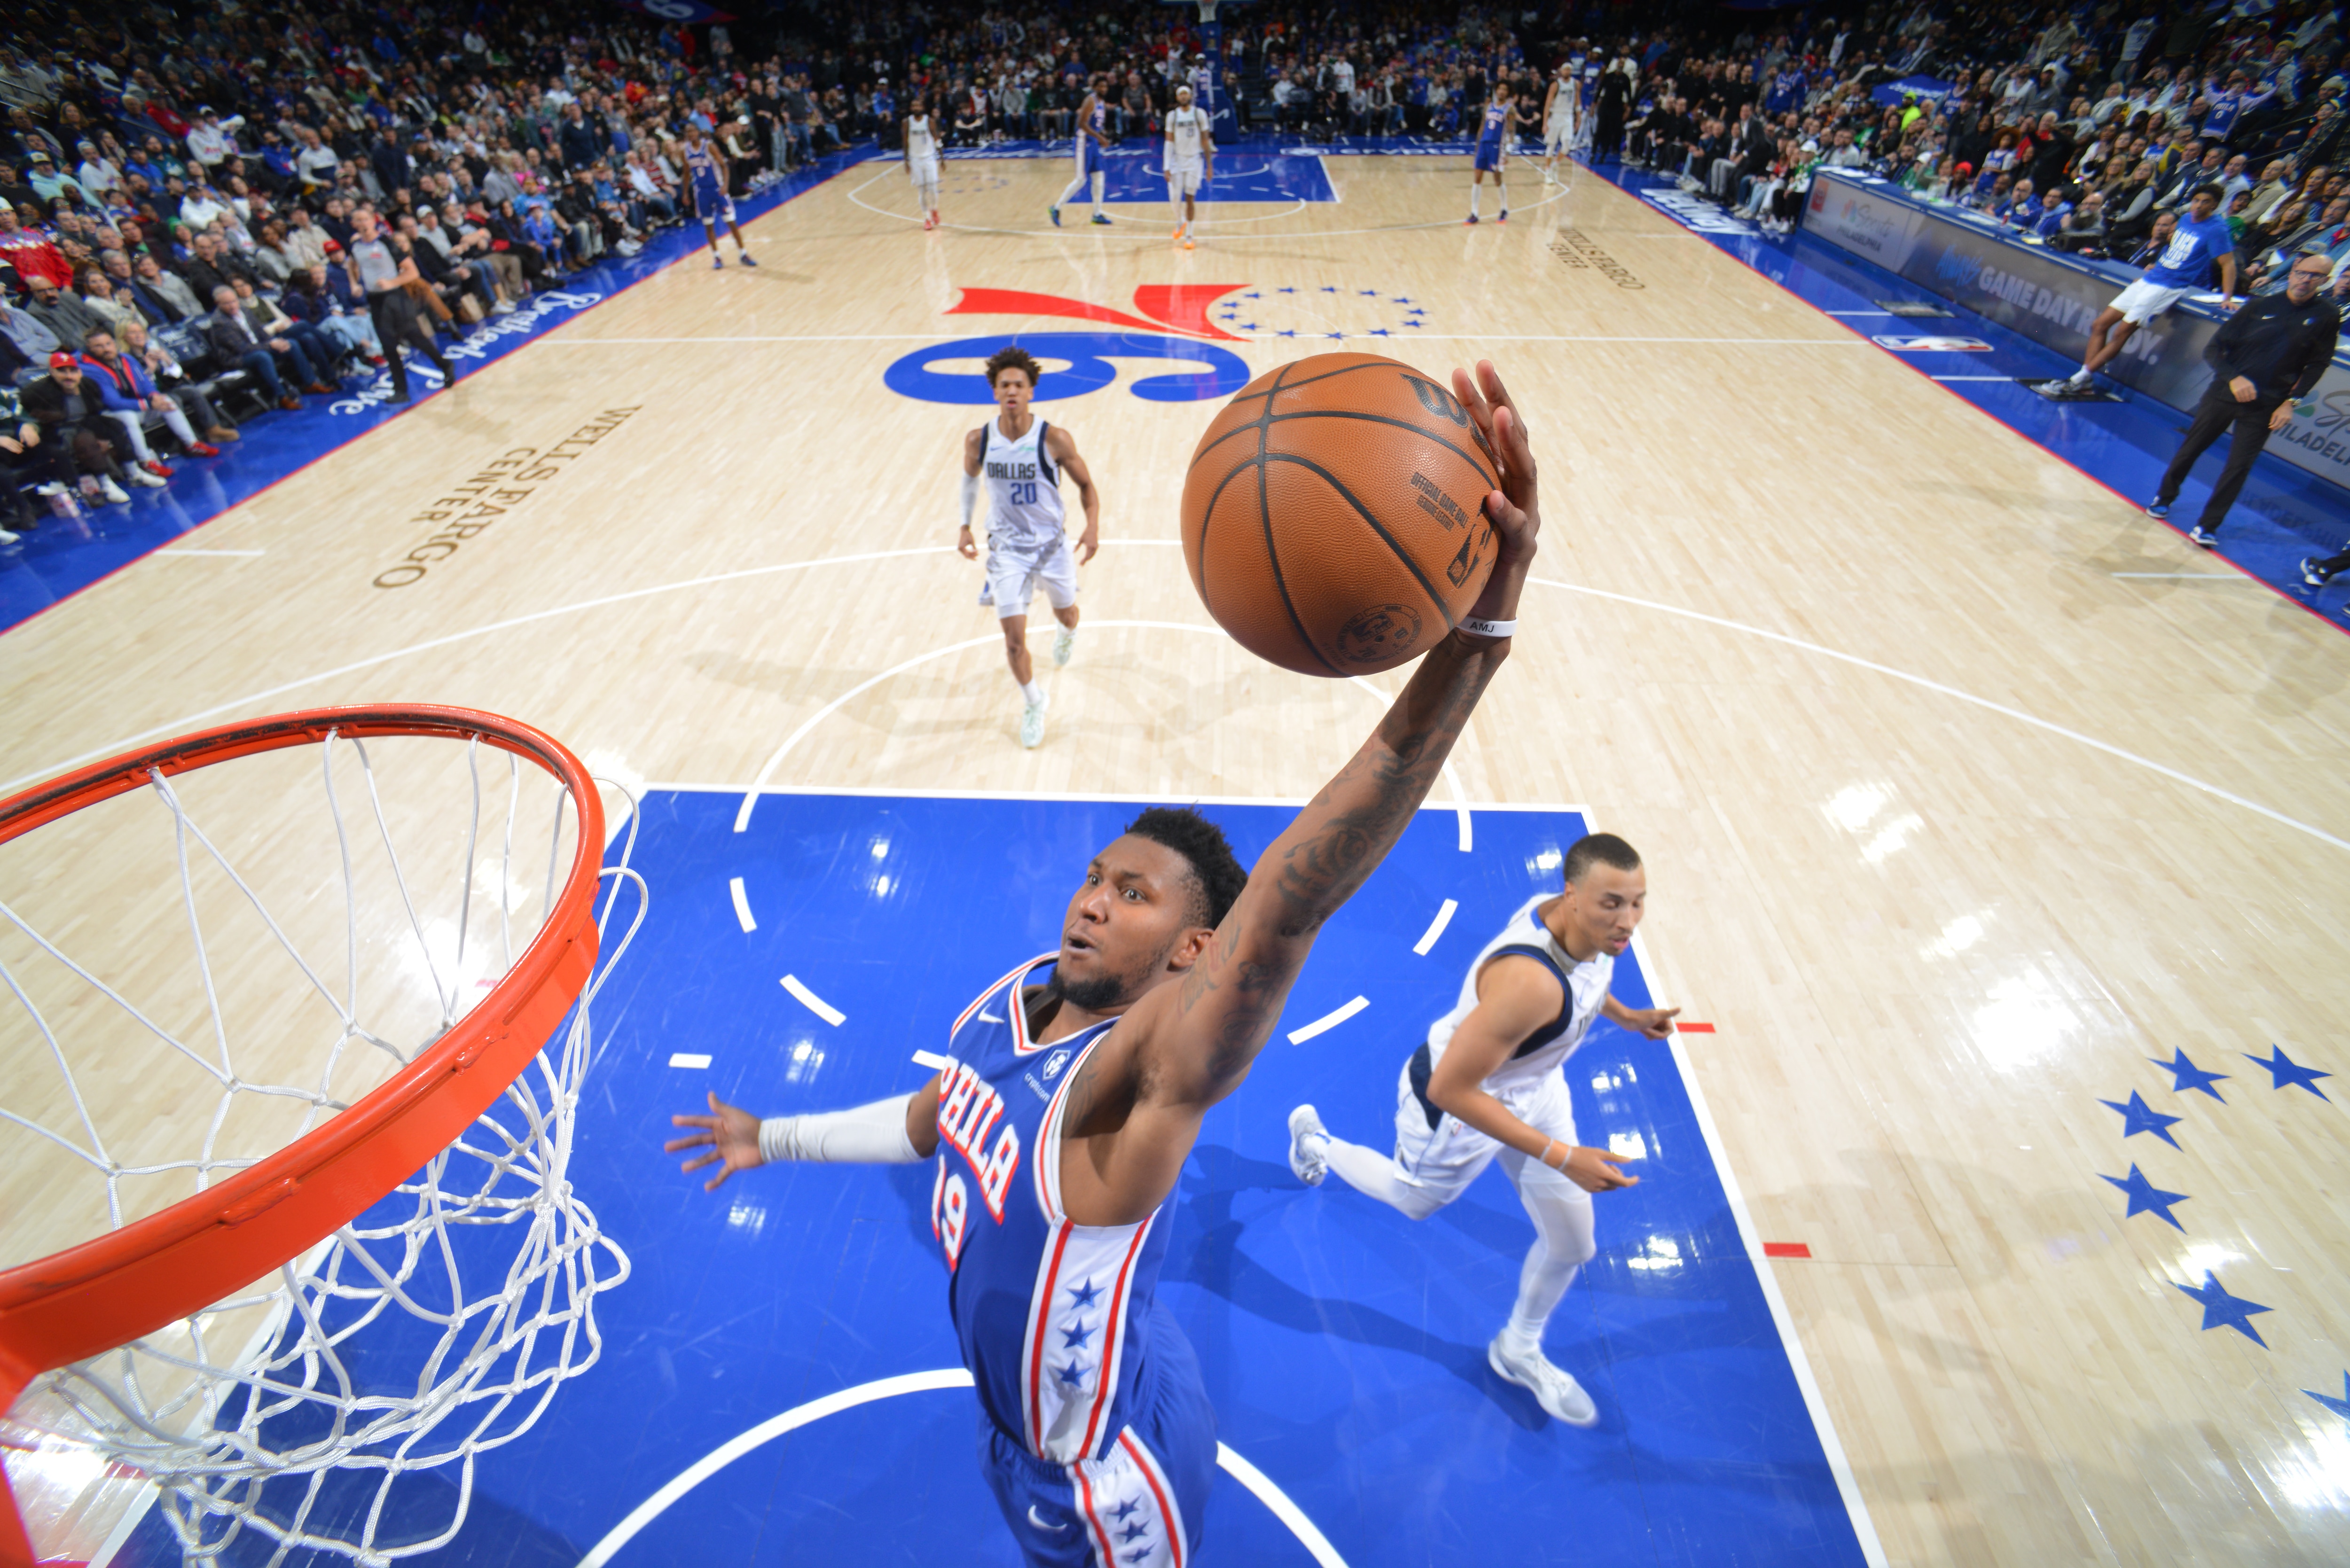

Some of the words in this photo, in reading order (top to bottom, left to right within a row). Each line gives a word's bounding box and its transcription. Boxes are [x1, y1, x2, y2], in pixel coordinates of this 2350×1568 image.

[1979, 266, 2037, 310] GAME
[2032, 288, 2080, 327] DAY
[2076, 305, 2163, 365] RDY.
[515, 405, 643, 482] WELLS
[987, 462, 1036, 479] DALLAS
[2273, 423, 2350, 466] ILADEL
[410, 447, 538, 523] CENTER
[1010, 483, 1037, 505] 20
[1411, 472, 1441, 502] OFFICIAL
[1439, 493, 1458, 517] GAME
[1454, 507, 1469, 529] BALL
[373, 487, 535, 589] FARGO
[1435, 510, 1455, 532] LEATHER
[1469, 621, 1495, 633] AMJ
[937, 1054, 1020, 1225] PHILA
